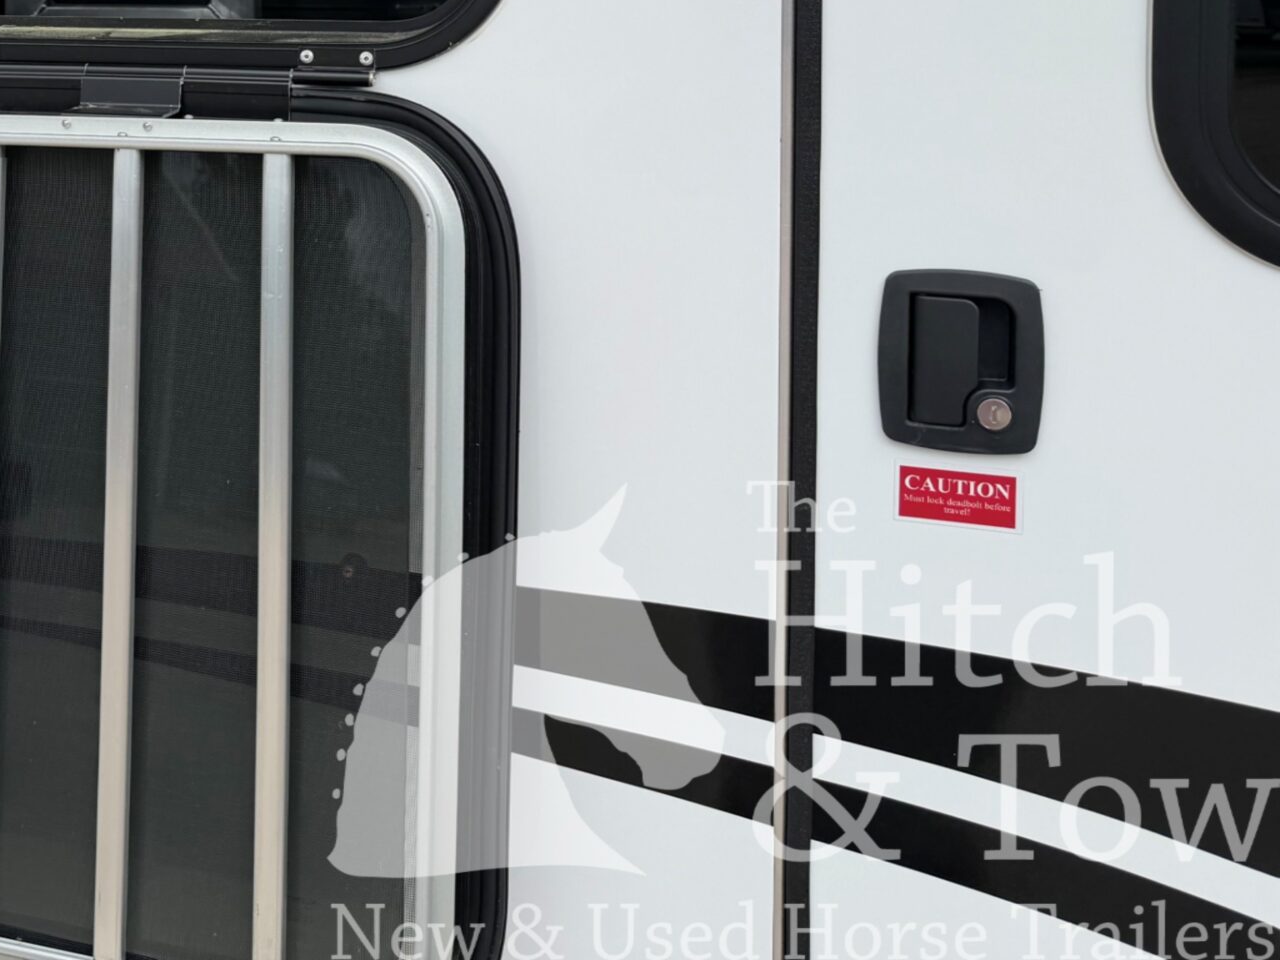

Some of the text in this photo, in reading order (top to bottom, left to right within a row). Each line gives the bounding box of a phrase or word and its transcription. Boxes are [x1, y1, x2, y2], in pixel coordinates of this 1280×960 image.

[904, 474, 1011, 500] CAUTION
[904, 493, 1012, 513] Must lock deadbolt before
